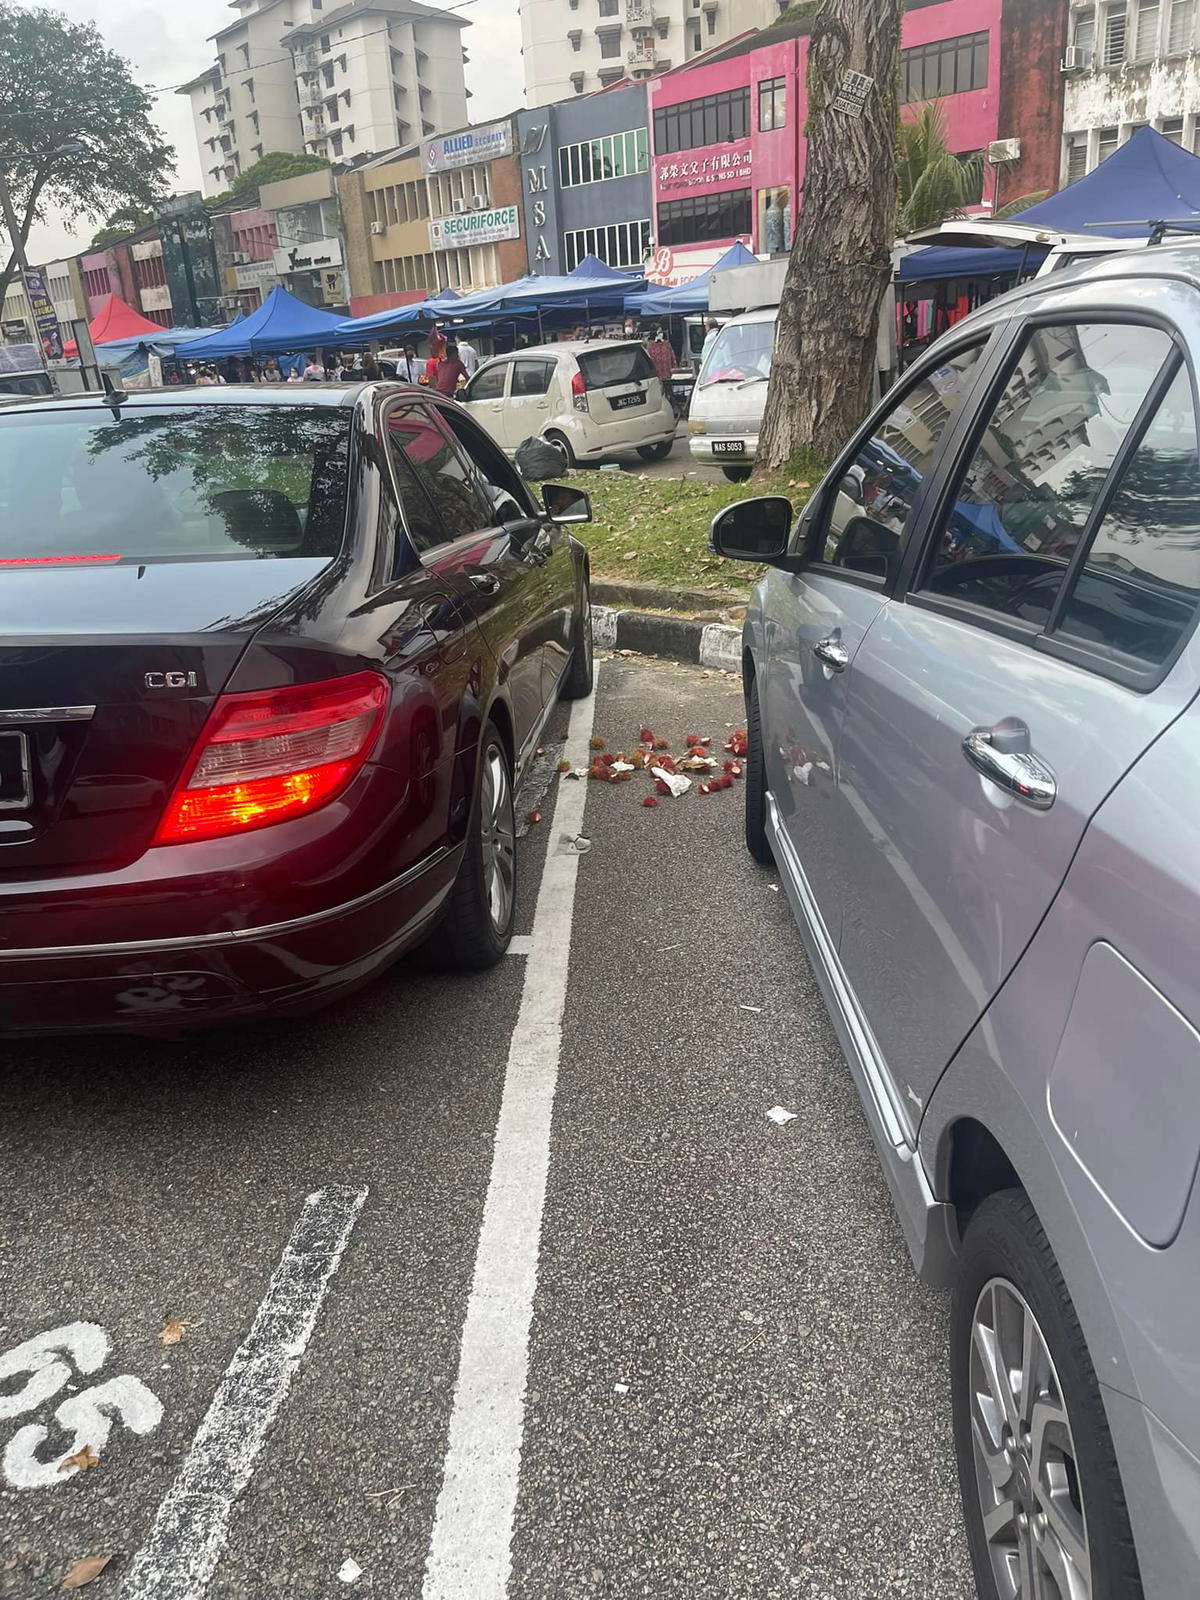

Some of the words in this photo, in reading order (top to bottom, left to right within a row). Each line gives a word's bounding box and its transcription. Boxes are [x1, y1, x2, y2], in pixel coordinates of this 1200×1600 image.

[443, 134, 472, 154] ALLIED
[739, 167, 751, 177] BHD
[444, 208, 515, 235] SECURIFORCE
[714, 442, 726, 451] NAS
[726, 441, 742, 451] 5053
[144, 671, 198, 688] CGI
